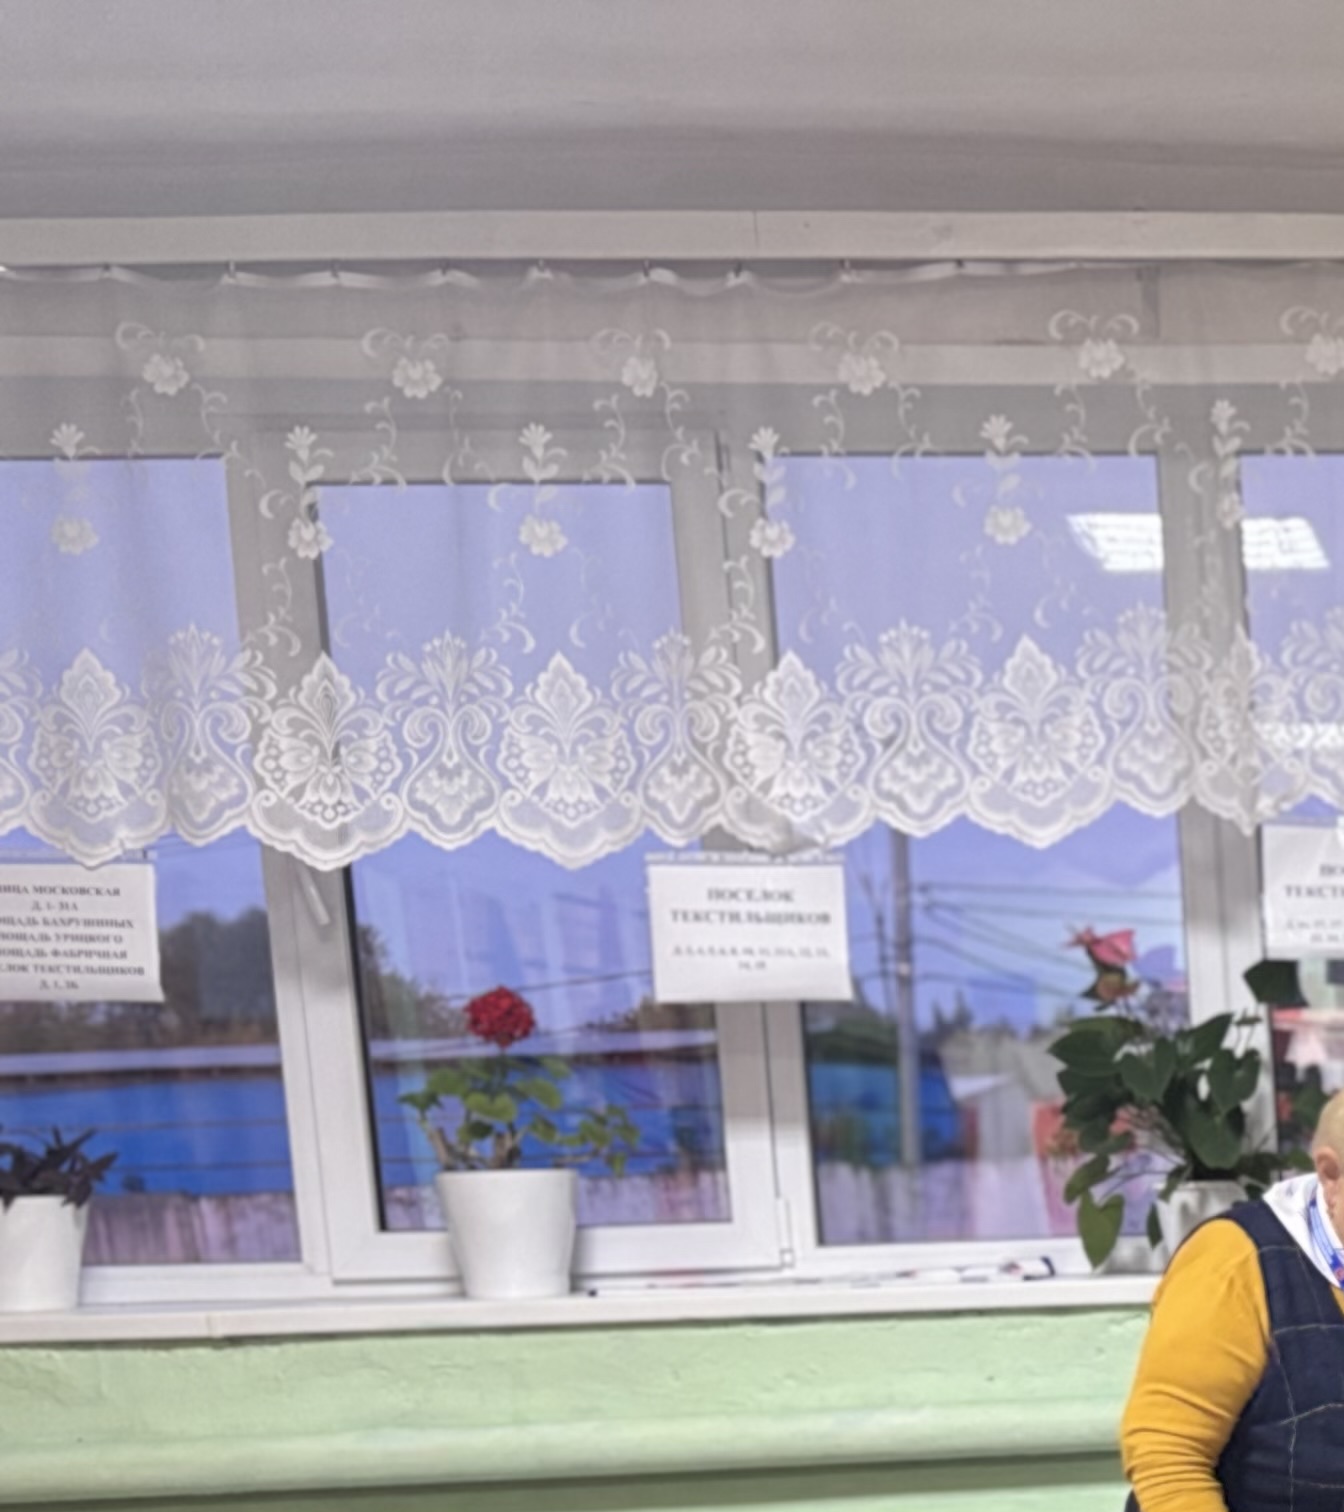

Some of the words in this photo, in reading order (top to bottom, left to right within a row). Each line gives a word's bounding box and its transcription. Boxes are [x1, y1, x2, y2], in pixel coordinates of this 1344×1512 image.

[0, 884, 29, 895] ИЦА
[32, 885, 121, 897] МОСКОВСКАЯ
[707, 888, 795, 903] ПОСЕЛОК
[670, 909, 832, 926] ТЕКСТИЛЬЩИКОВ
[54, 933, 123, 944] УРИЦКОГО
[51, 949, 128, 960] ФАБРИЧНАЯ
[32, 965, 145, 977] ТЕКСТИЛЬЩИКОВ
